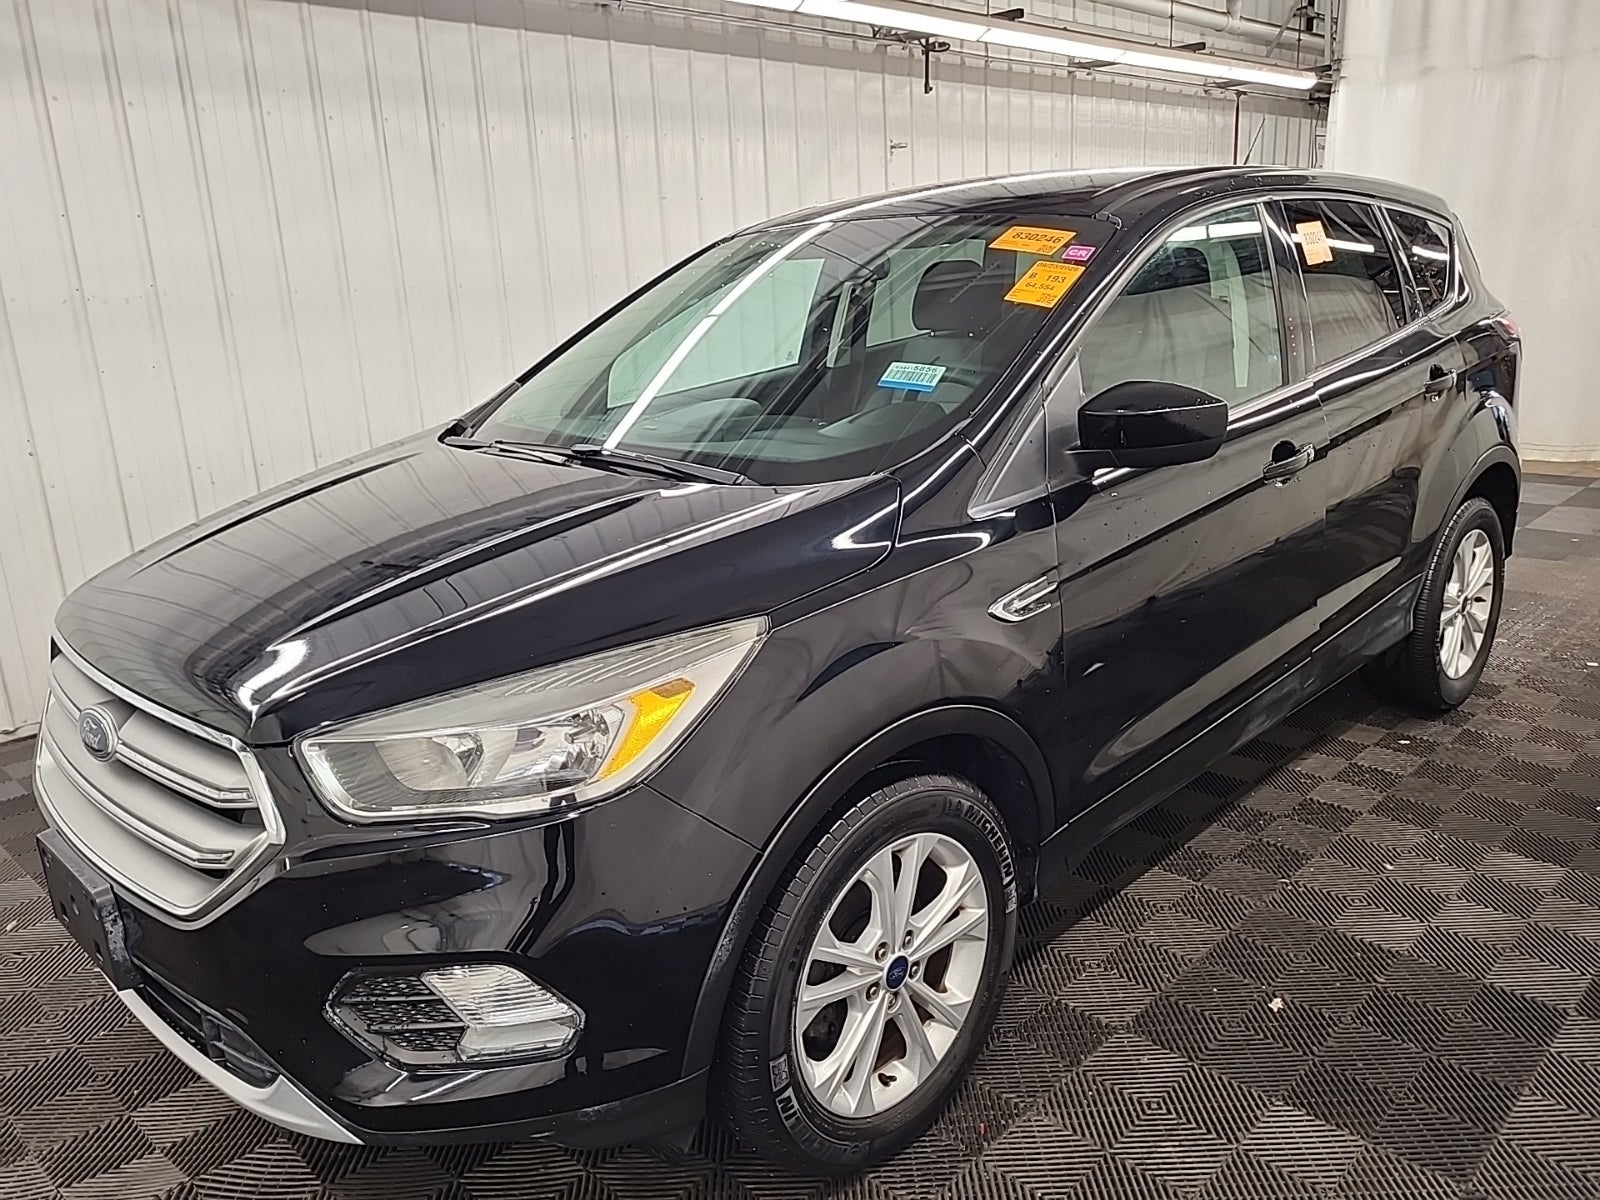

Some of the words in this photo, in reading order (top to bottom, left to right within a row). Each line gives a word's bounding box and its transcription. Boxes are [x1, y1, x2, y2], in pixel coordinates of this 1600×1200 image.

[1012, 231, 1064, 244] 830246
[1068, 249, 1088, 257] CR
[1028, 272, 1038, 280] B
[1045, 274, 1067, 284] 193
[1025, 281, 1055, 291] 64,554
[964, 804, 1014, 877] MICHELIN
